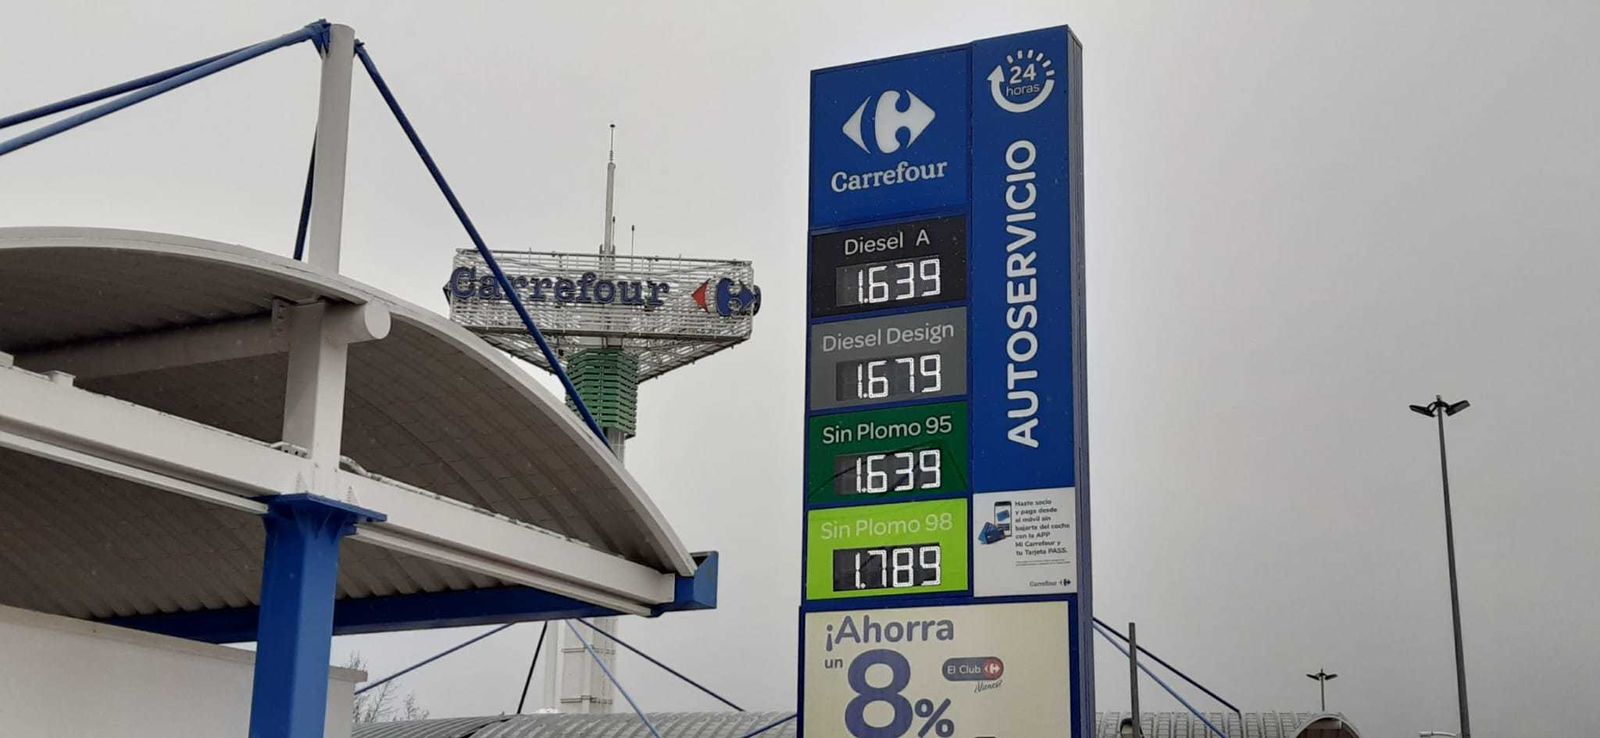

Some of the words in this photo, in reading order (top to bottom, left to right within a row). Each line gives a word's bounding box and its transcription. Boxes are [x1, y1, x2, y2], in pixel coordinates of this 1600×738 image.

[1009, 64, 1037, 83] 24
[1005, 82, 1040, 97] horas
[831, 160, 948, 193] Carrefour
[844, 232, 904, 255] Diesel
[915, 229, 931, 246] A
[857, 257, 941, 304] 1.639
[1005, 139, 1039, 448] AUTOSERVICIO
[822, 328, 882, 352] Diesel
[887, 322, 955, 345] Design
[857, 353, 942, 399] 1.679
[822, 423, 852, 444] Sin
[857, 418, 921, 441] Plomo
[925, 415, 952, 434] 95
[856, 449, 941, 494] 1.639
[821, 521, 850, 540] Sin
[856, 515, 921, 537] Plomo
[925, 512, 953, 531] 98
[855, 546, 941, 589] 1.789
[825, 614, 954, 651] ¡Ahorra
[824, 657, 843, 669] un
[959, 664, 981, 675] Club
